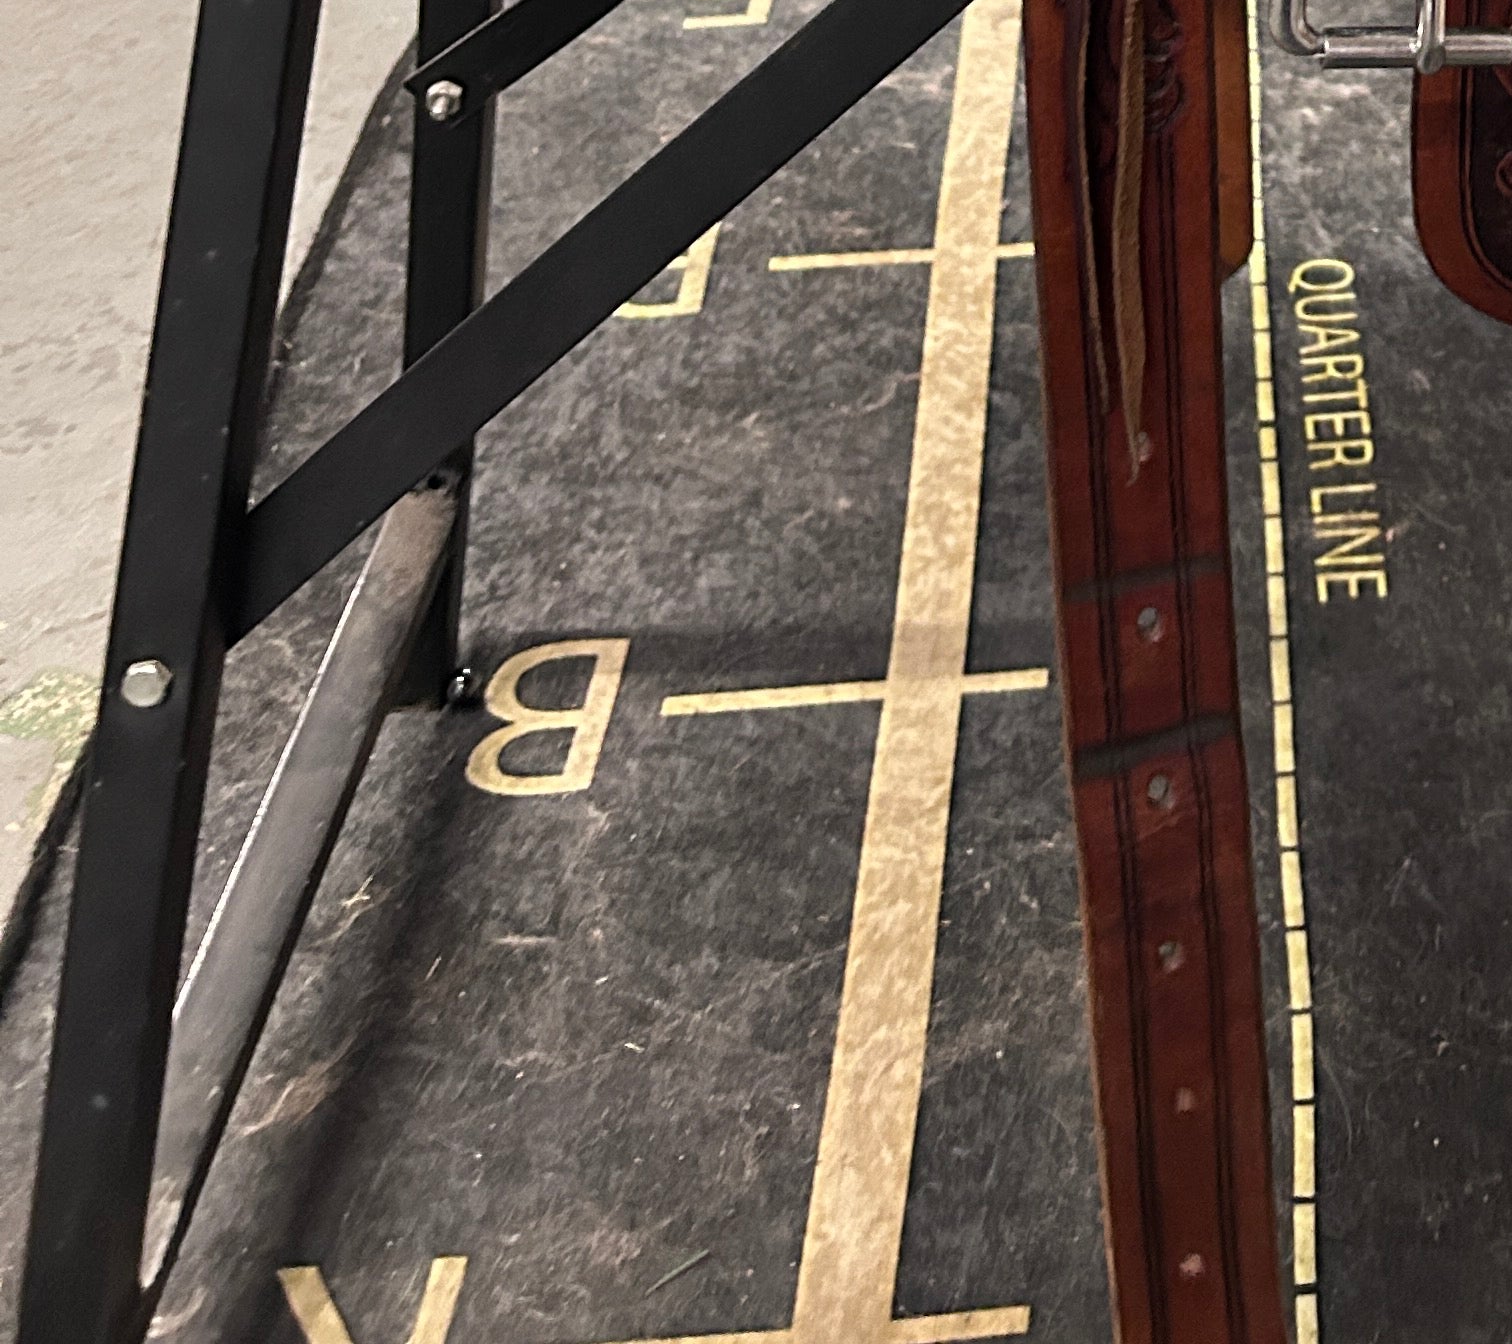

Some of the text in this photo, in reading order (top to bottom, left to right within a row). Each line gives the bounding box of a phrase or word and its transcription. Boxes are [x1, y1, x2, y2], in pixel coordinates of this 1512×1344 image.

[1288, 258, 1388, 603] QUARTER LINE
[464, 637, 631, 796] B
